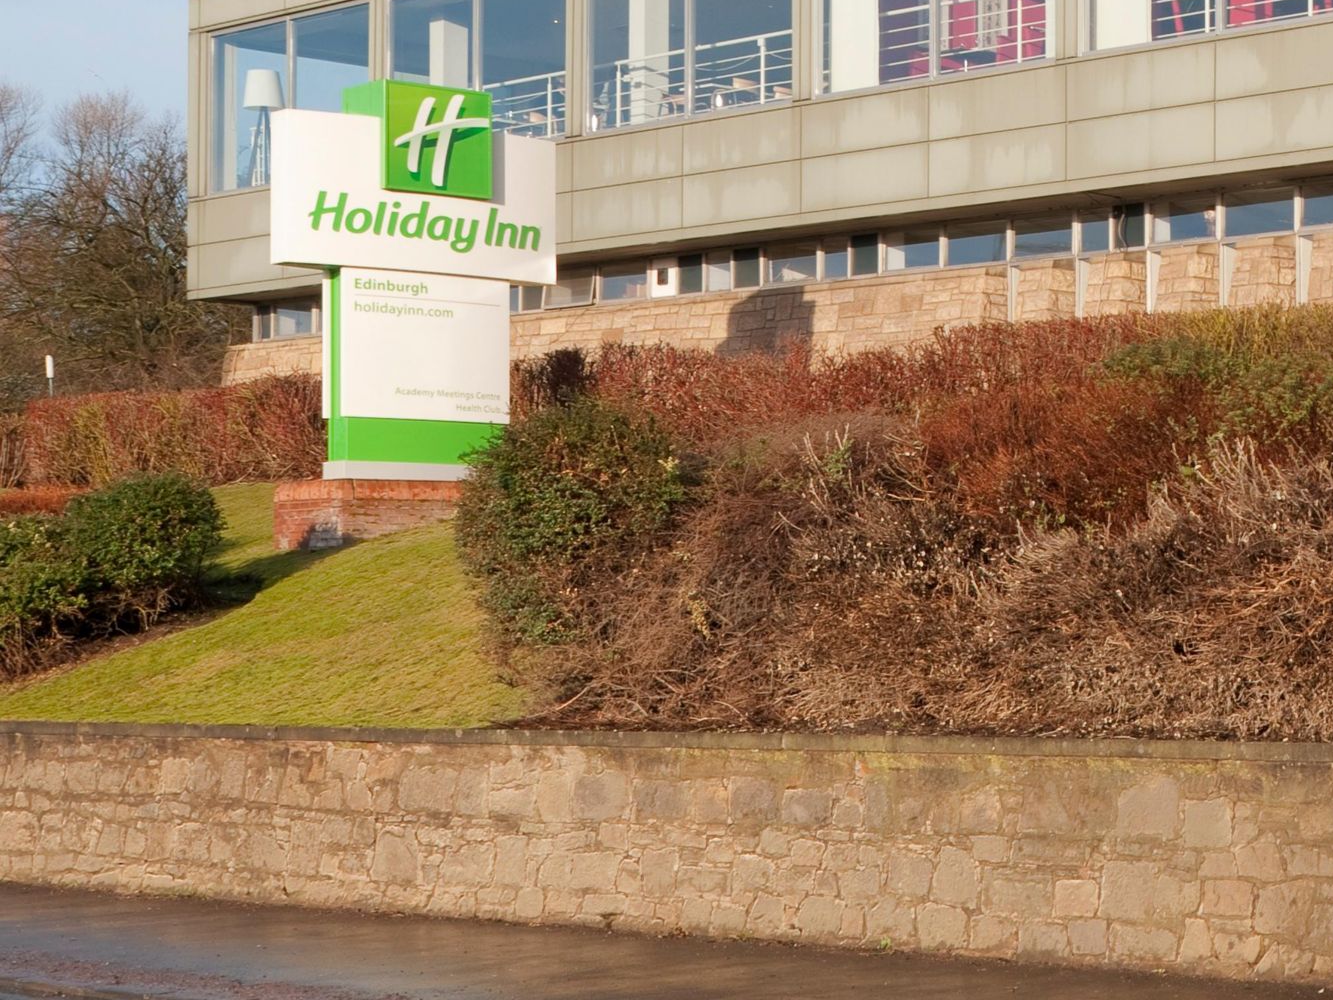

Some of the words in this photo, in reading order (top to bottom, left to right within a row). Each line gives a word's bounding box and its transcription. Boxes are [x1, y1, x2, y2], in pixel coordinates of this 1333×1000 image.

[308, 191, 479, 253] Holiday
[484, 207, 541, 253] Inn
[354, 278, 428, 296] Edinburgh
[354, 301, 454, 319] holidayinn.com
[395, 387, 435, 398] Academy
[437, 390, 475, 401] Meetings
[456, 404, 482, 413] Health
